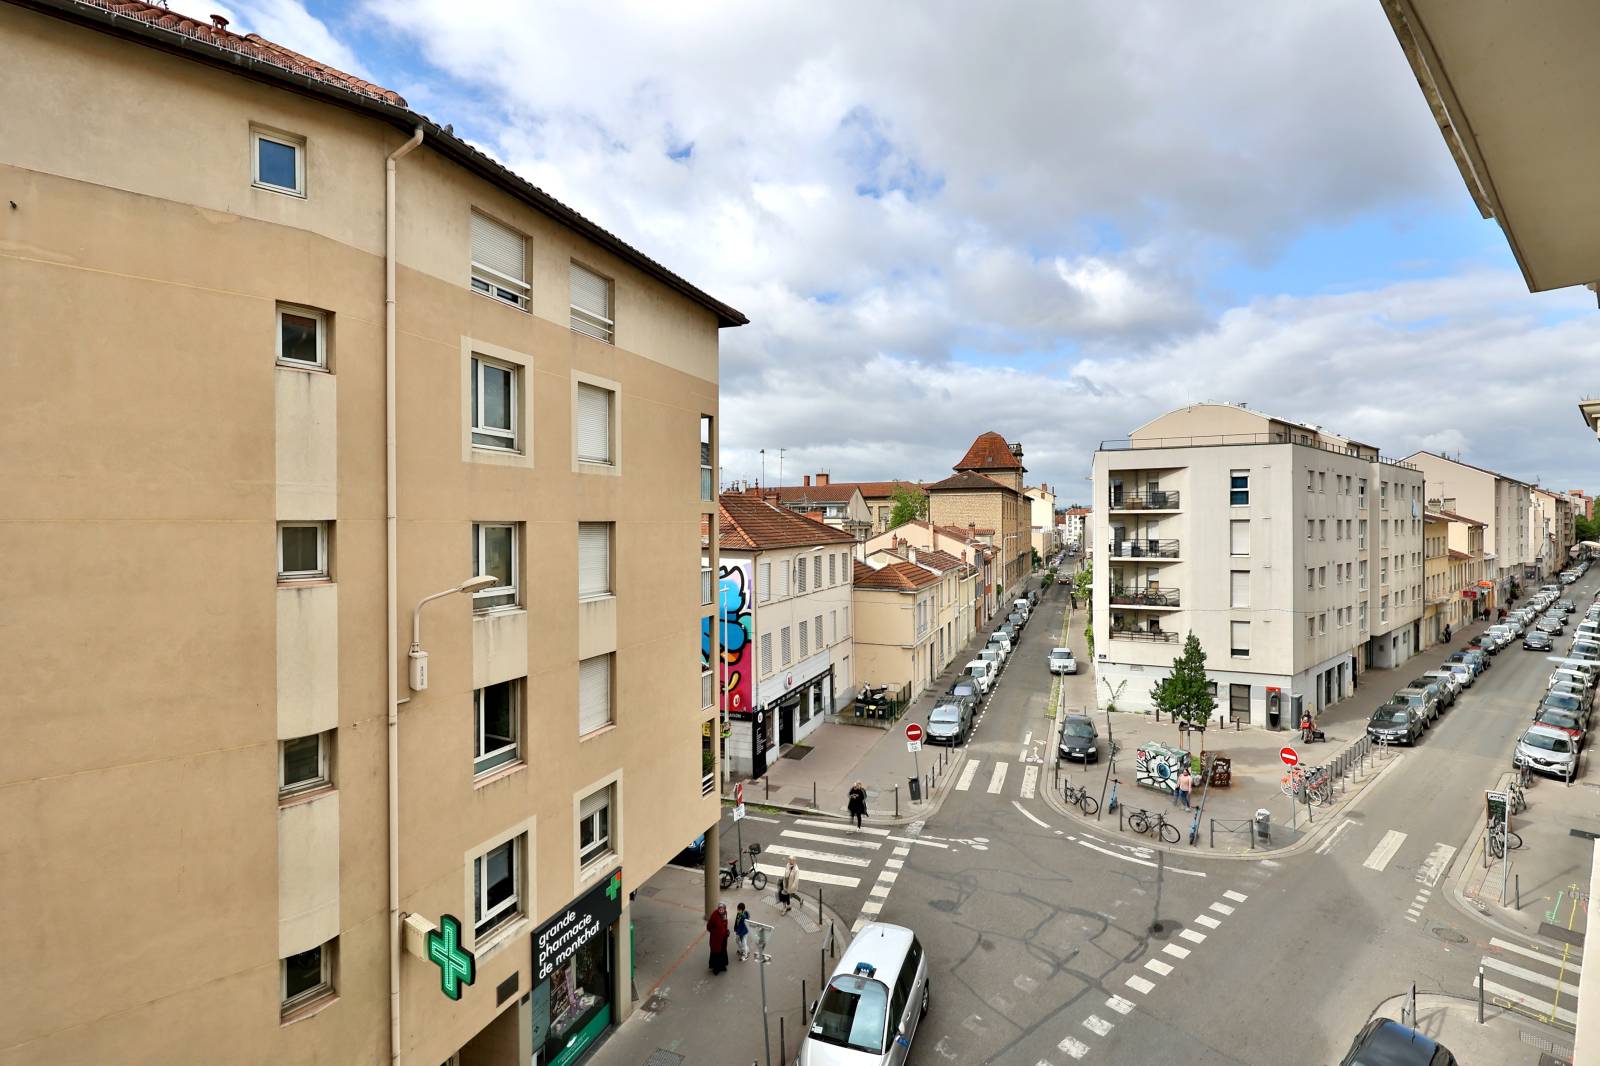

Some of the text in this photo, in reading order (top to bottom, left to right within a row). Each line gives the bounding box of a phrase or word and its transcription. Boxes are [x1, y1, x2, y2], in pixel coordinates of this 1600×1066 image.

[539, 910, 576, 948] grande
[539, 914, 592, 966] pharmacie
[539, 920, 600, 979] de montchat
